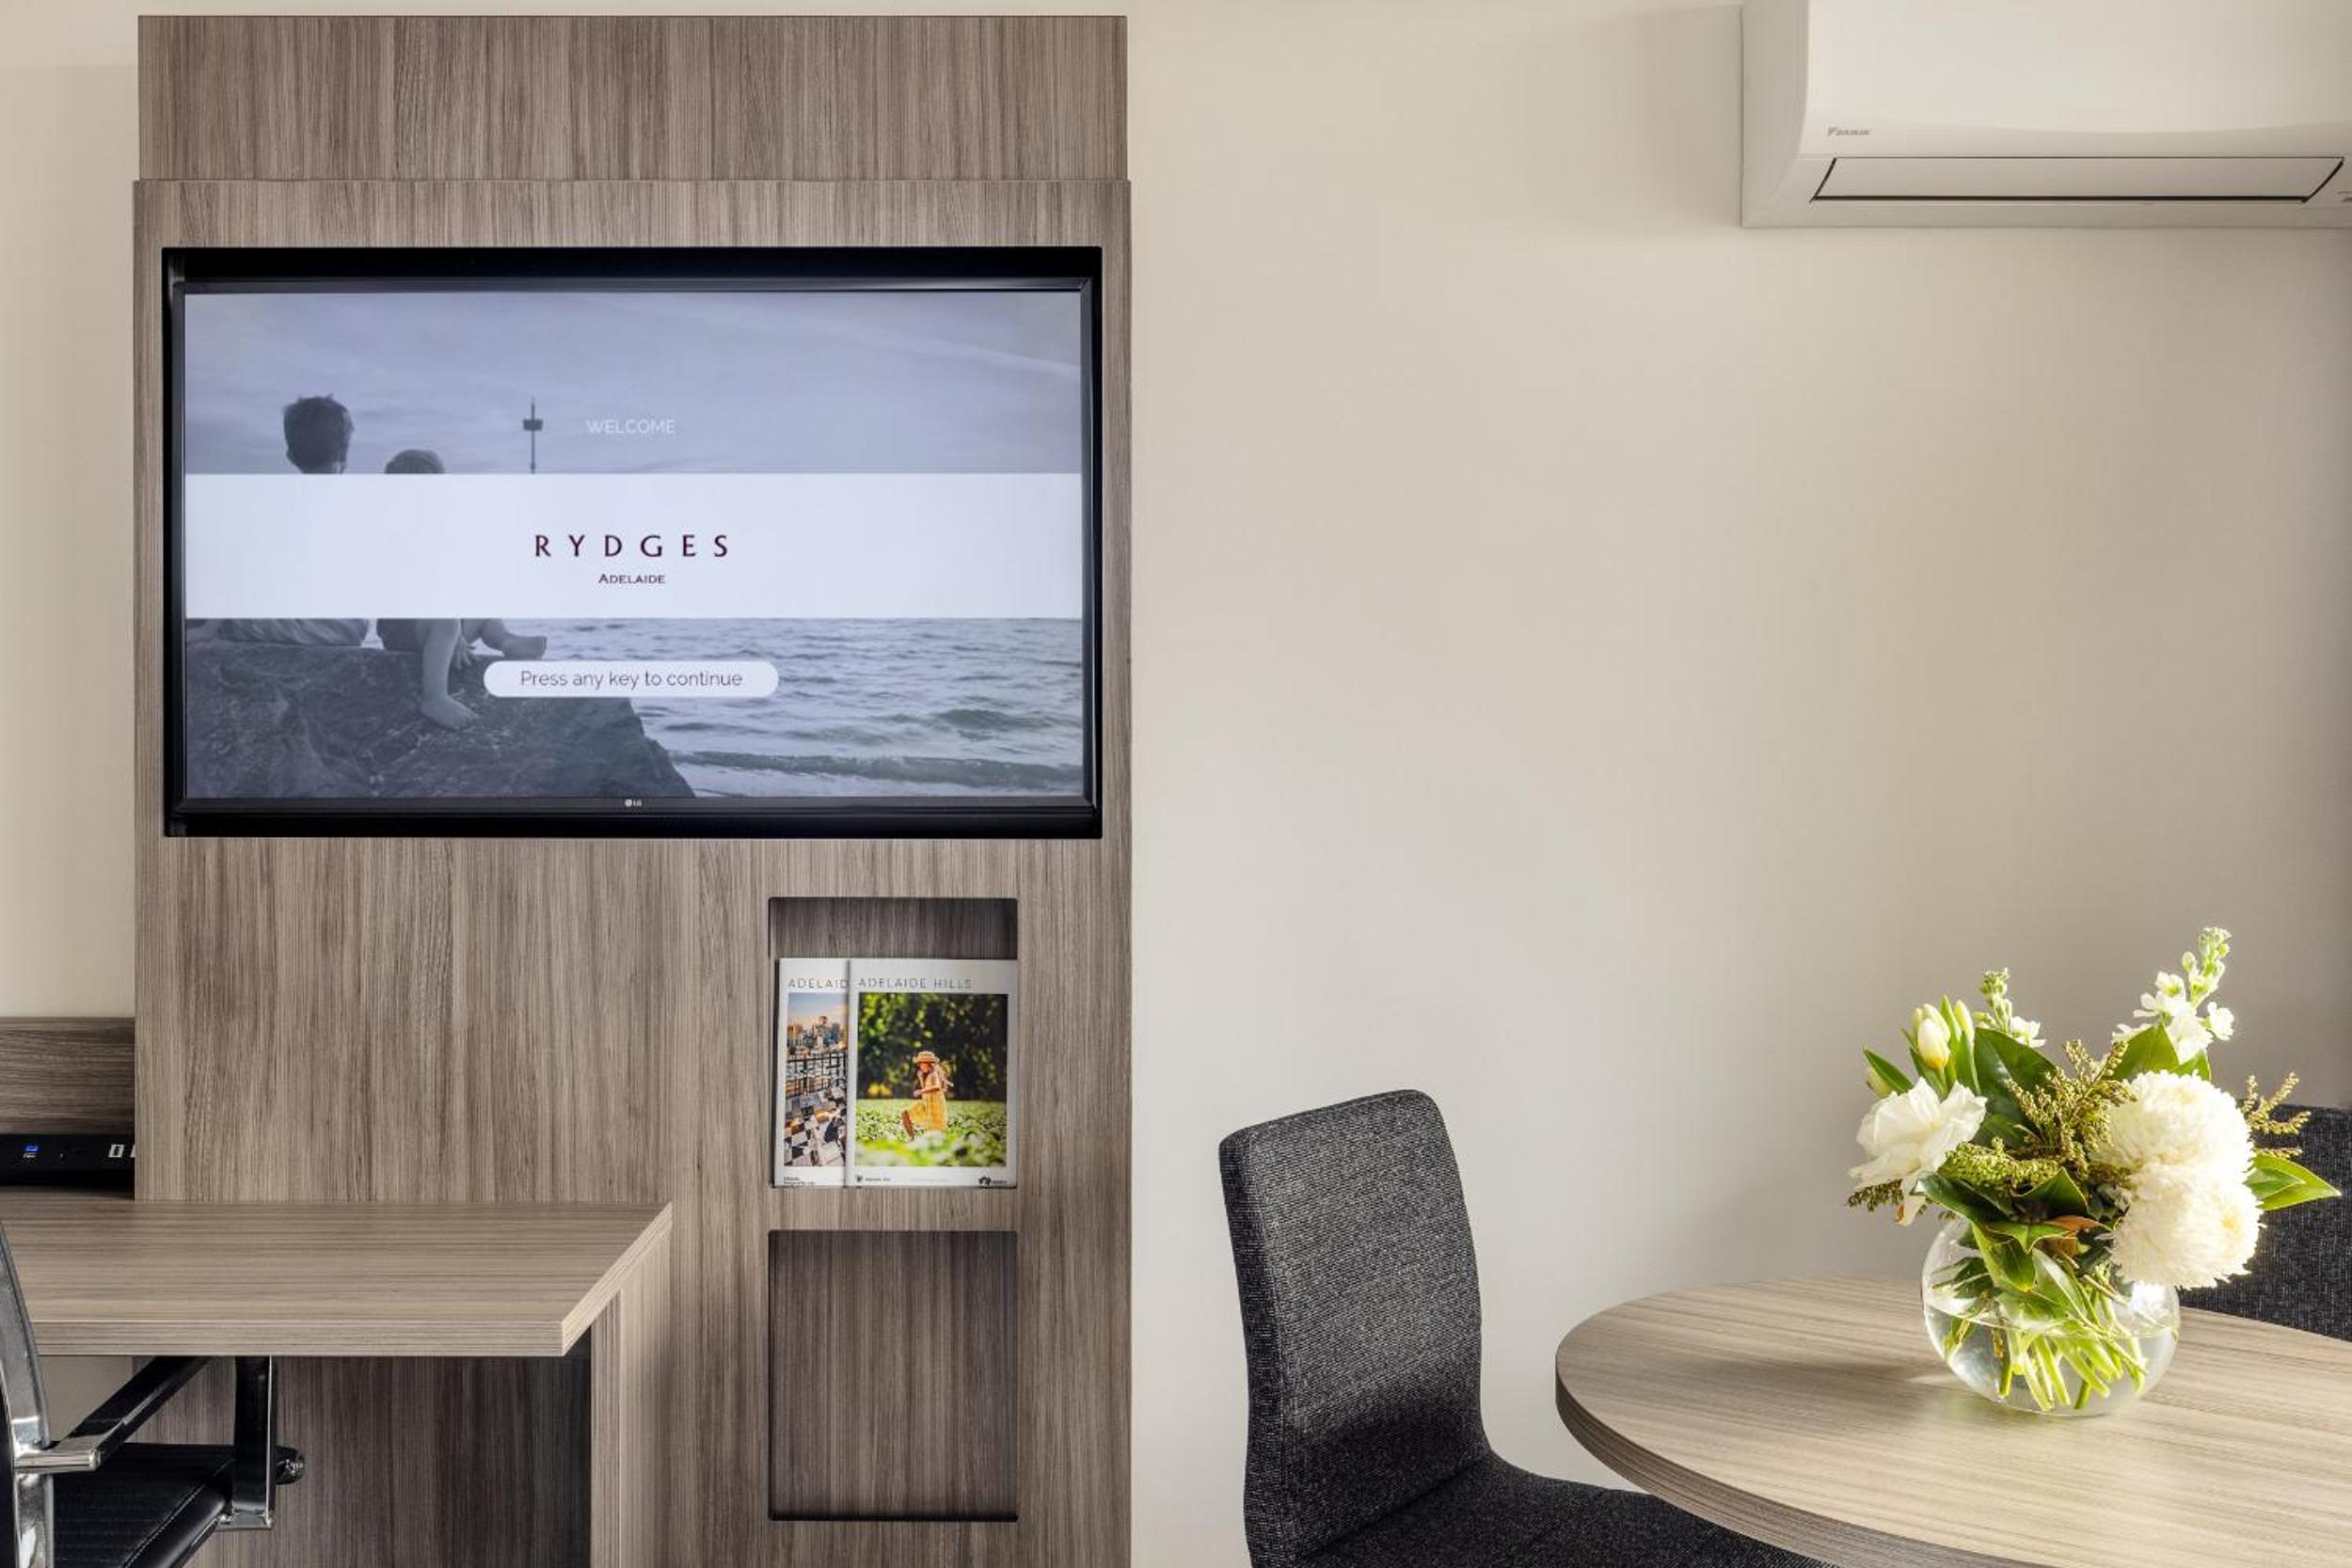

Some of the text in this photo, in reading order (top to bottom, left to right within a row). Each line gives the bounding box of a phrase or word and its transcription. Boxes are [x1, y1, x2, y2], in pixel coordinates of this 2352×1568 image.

[586, 419, 675, 435] WELCOME
[534, 533, 729, 558] RYDGES
[520, 670, 743, 690] Press any key to continue
[788, 977, 849, 989] ADELAID
[858, 977, 972, 989] ADELAIDE HILLS
